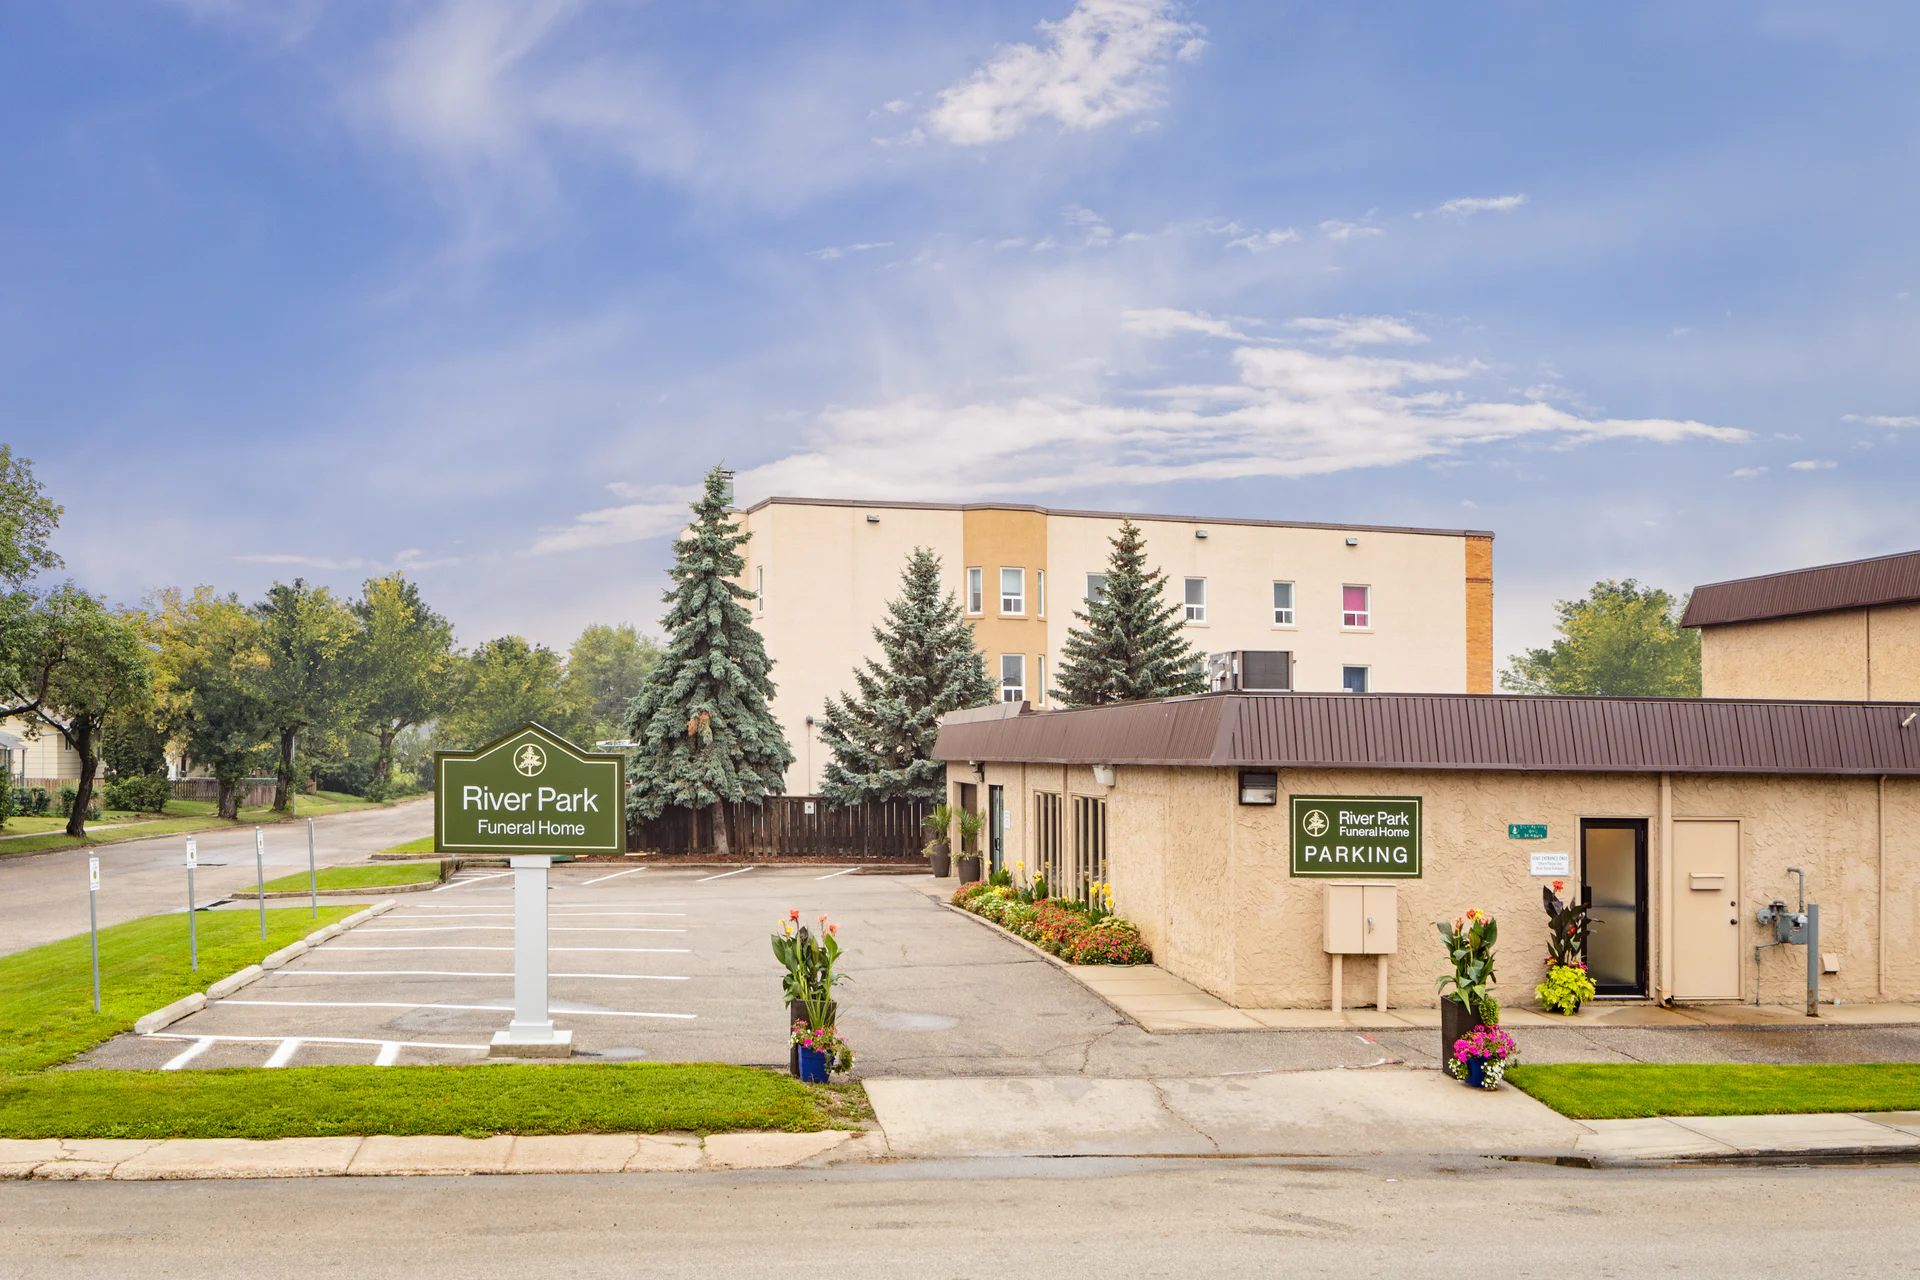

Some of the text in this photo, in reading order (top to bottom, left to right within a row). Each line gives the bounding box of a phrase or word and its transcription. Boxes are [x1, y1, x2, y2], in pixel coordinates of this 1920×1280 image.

[463, 785, 599, 813] River Park
[1339, 810, 1409, 826] River Park
[478, 819, 585, 836] Funeral Home
[1339, 826, 1410, 838] Funeral Home
[1304, 845, 1408, 863] PARKING
